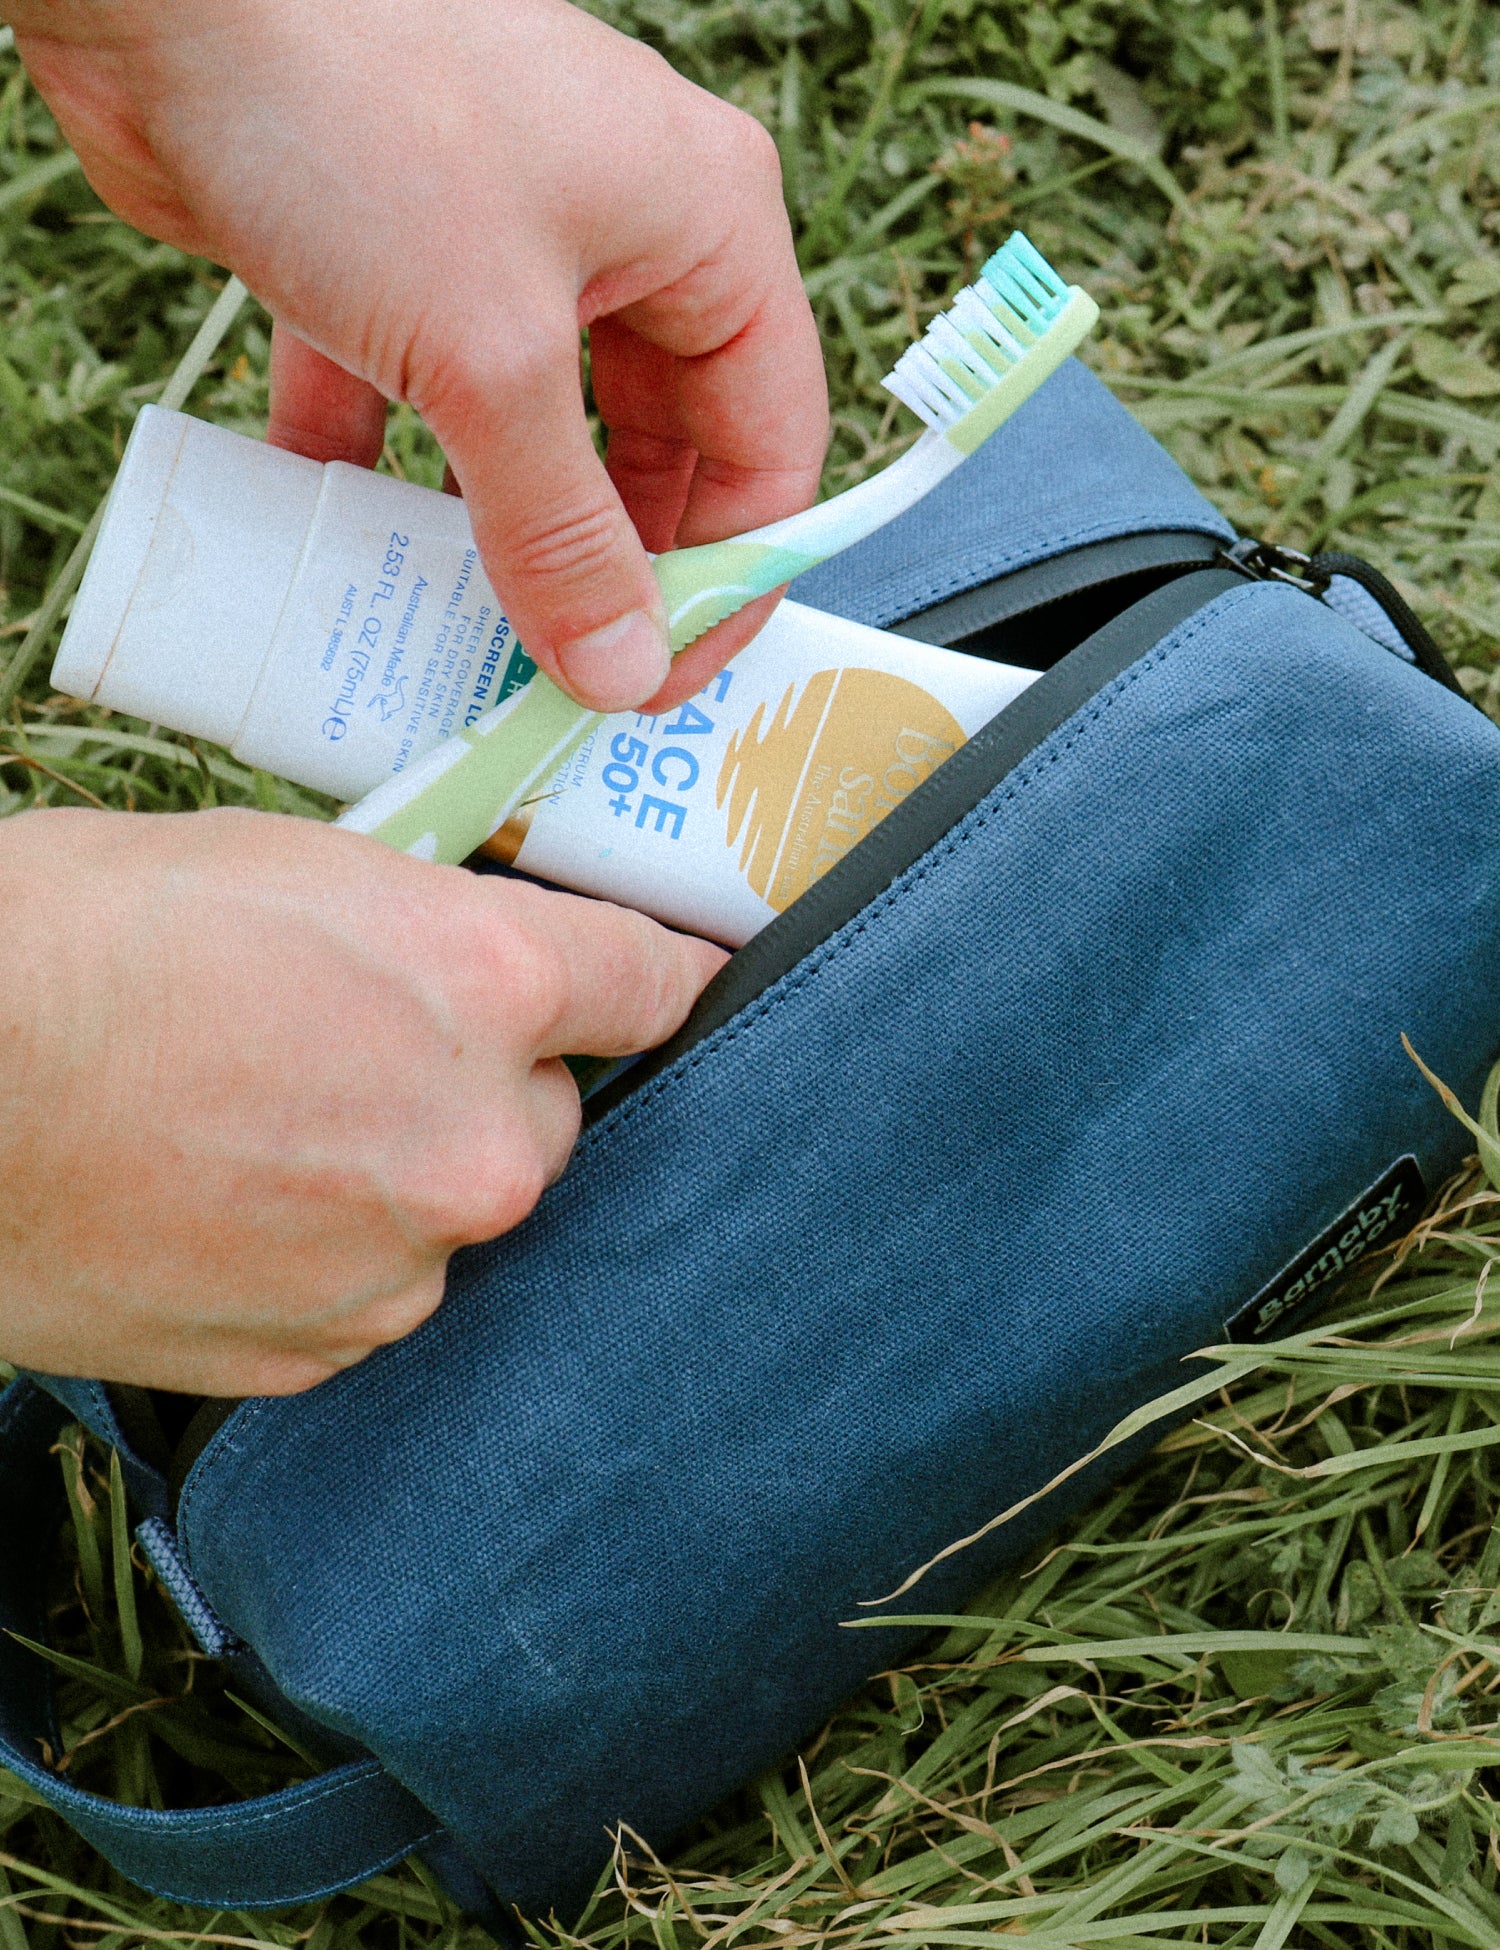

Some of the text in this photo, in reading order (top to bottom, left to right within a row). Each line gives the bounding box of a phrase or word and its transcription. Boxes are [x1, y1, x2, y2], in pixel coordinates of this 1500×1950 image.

[382, 531, 410, 577] 2.53
[340, 583, 358, 618] AUST
[370, 580, 395, 608] FL.
[381, 575, 429, 688] Australian Made
[358, 617, 382, 648] OZ
[392, 549, 477, 773] SUITABLE FOR SENSITIVE SKIN
[428, 615, 471, 718] FOR DRY SKIN
[329, 650, 371, 719] (75mL)
[438, 605, 491, 738] SHEER COVERAGE
[549, 753, 574, 806] CTION
[571, 729, 600, 788] CTRUM
[602, 732, 649, 817] 50+
[788, 791, 822, 872] Australian
[1257, 1183, 1404, 1323] Barnaby
